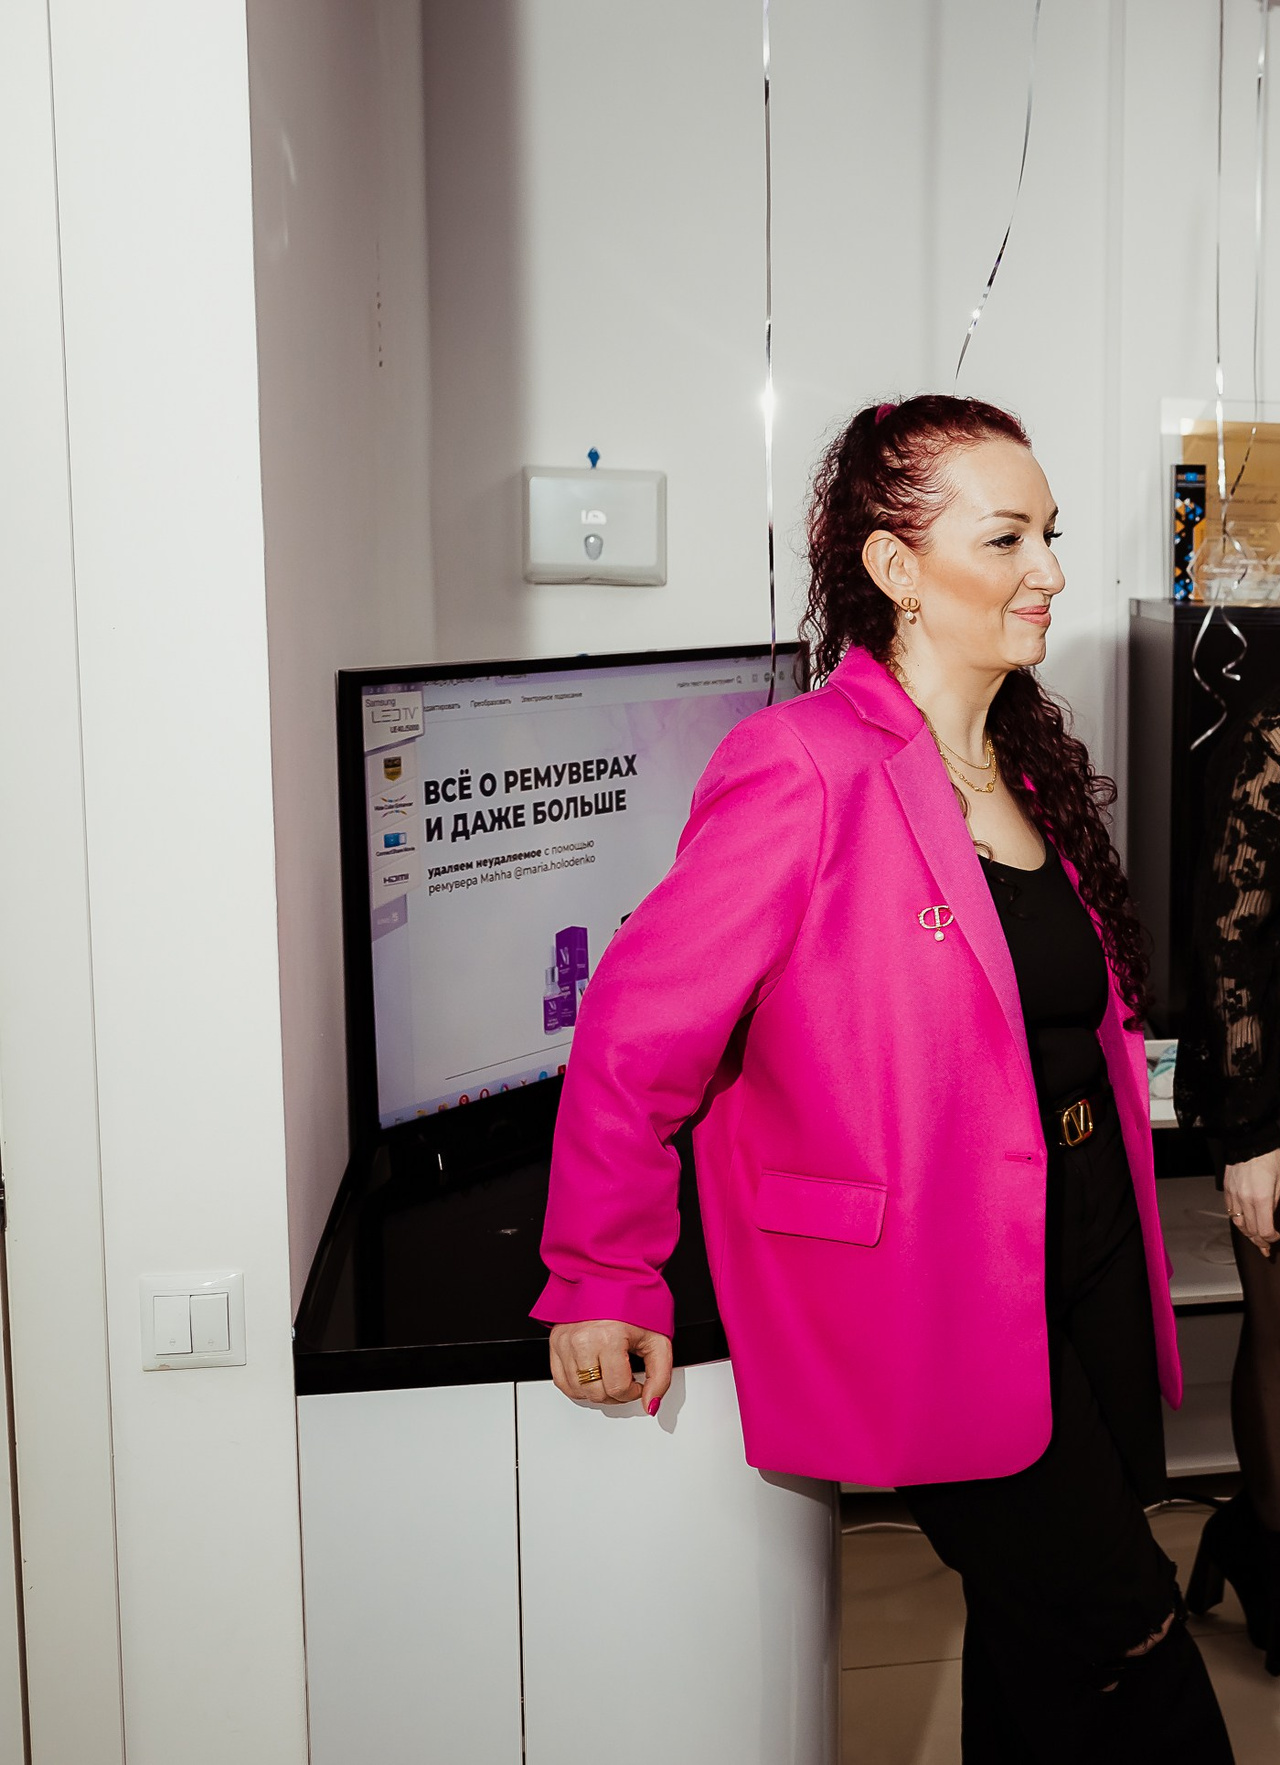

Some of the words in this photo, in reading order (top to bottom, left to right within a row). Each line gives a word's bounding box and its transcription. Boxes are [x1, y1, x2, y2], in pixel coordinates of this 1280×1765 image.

[365, 698, 396, 708] Samsung
[372, 708, 401, 724] LED
[402, 707, 418, 721] TV
[424, 768, 472, 805] ВСЁ
[479, 772, 497, 797] О
[504, 754, 638, 794] РЕМУВЕРАХ
[425, 817, 443, 843] И
[451, 804, 526, 843] ДАЖЕ
[533, 789, 627, 825] БОЛЬШЕ
[383, 873, 409, 884] HDMI
[427, 860, 474, 880] удаляем
[476, 849, 542, 869] неудаляемое
[544, 847, 550, 855] с
[551, 839, 595, 855] помощью
[428, 876, 478, 896] ремувера
[480, 869, 512, 884] Mahha
[513, 853, 596, 880] @maria.holodenko
